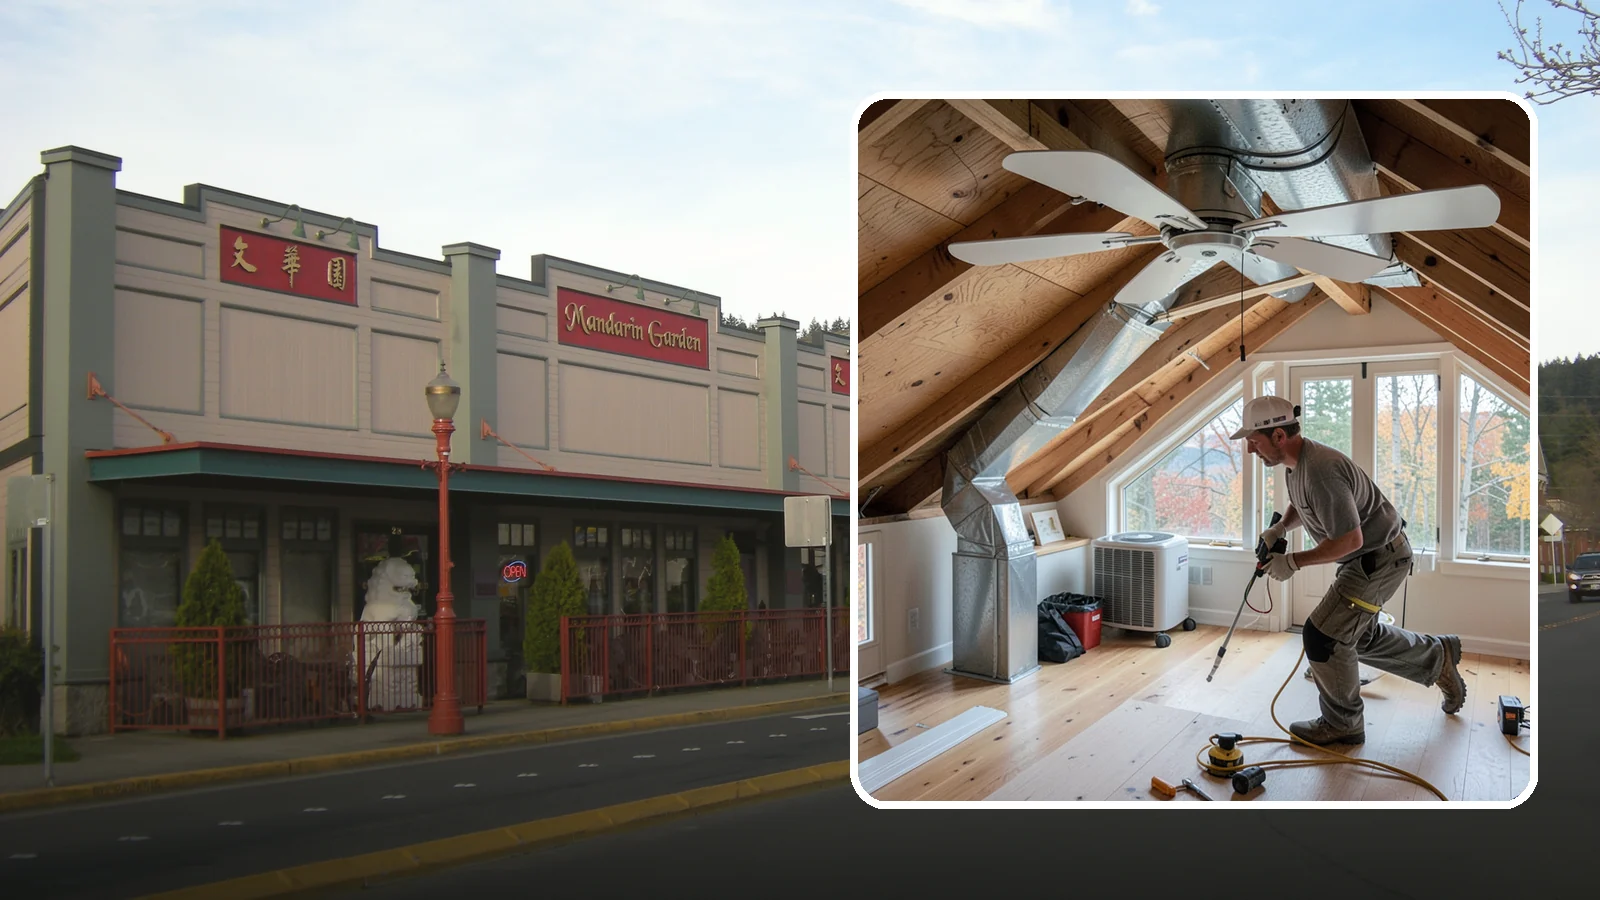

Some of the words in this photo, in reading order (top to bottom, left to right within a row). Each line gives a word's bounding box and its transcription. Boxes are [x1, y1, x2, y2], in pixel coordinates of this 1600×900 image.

[231, 235, 346, 291] 文華園
[564, 302, 644, 341] Mandarin
[647, 320, 702, 353] Garden
[503, 565, 527, 578] OPEN
